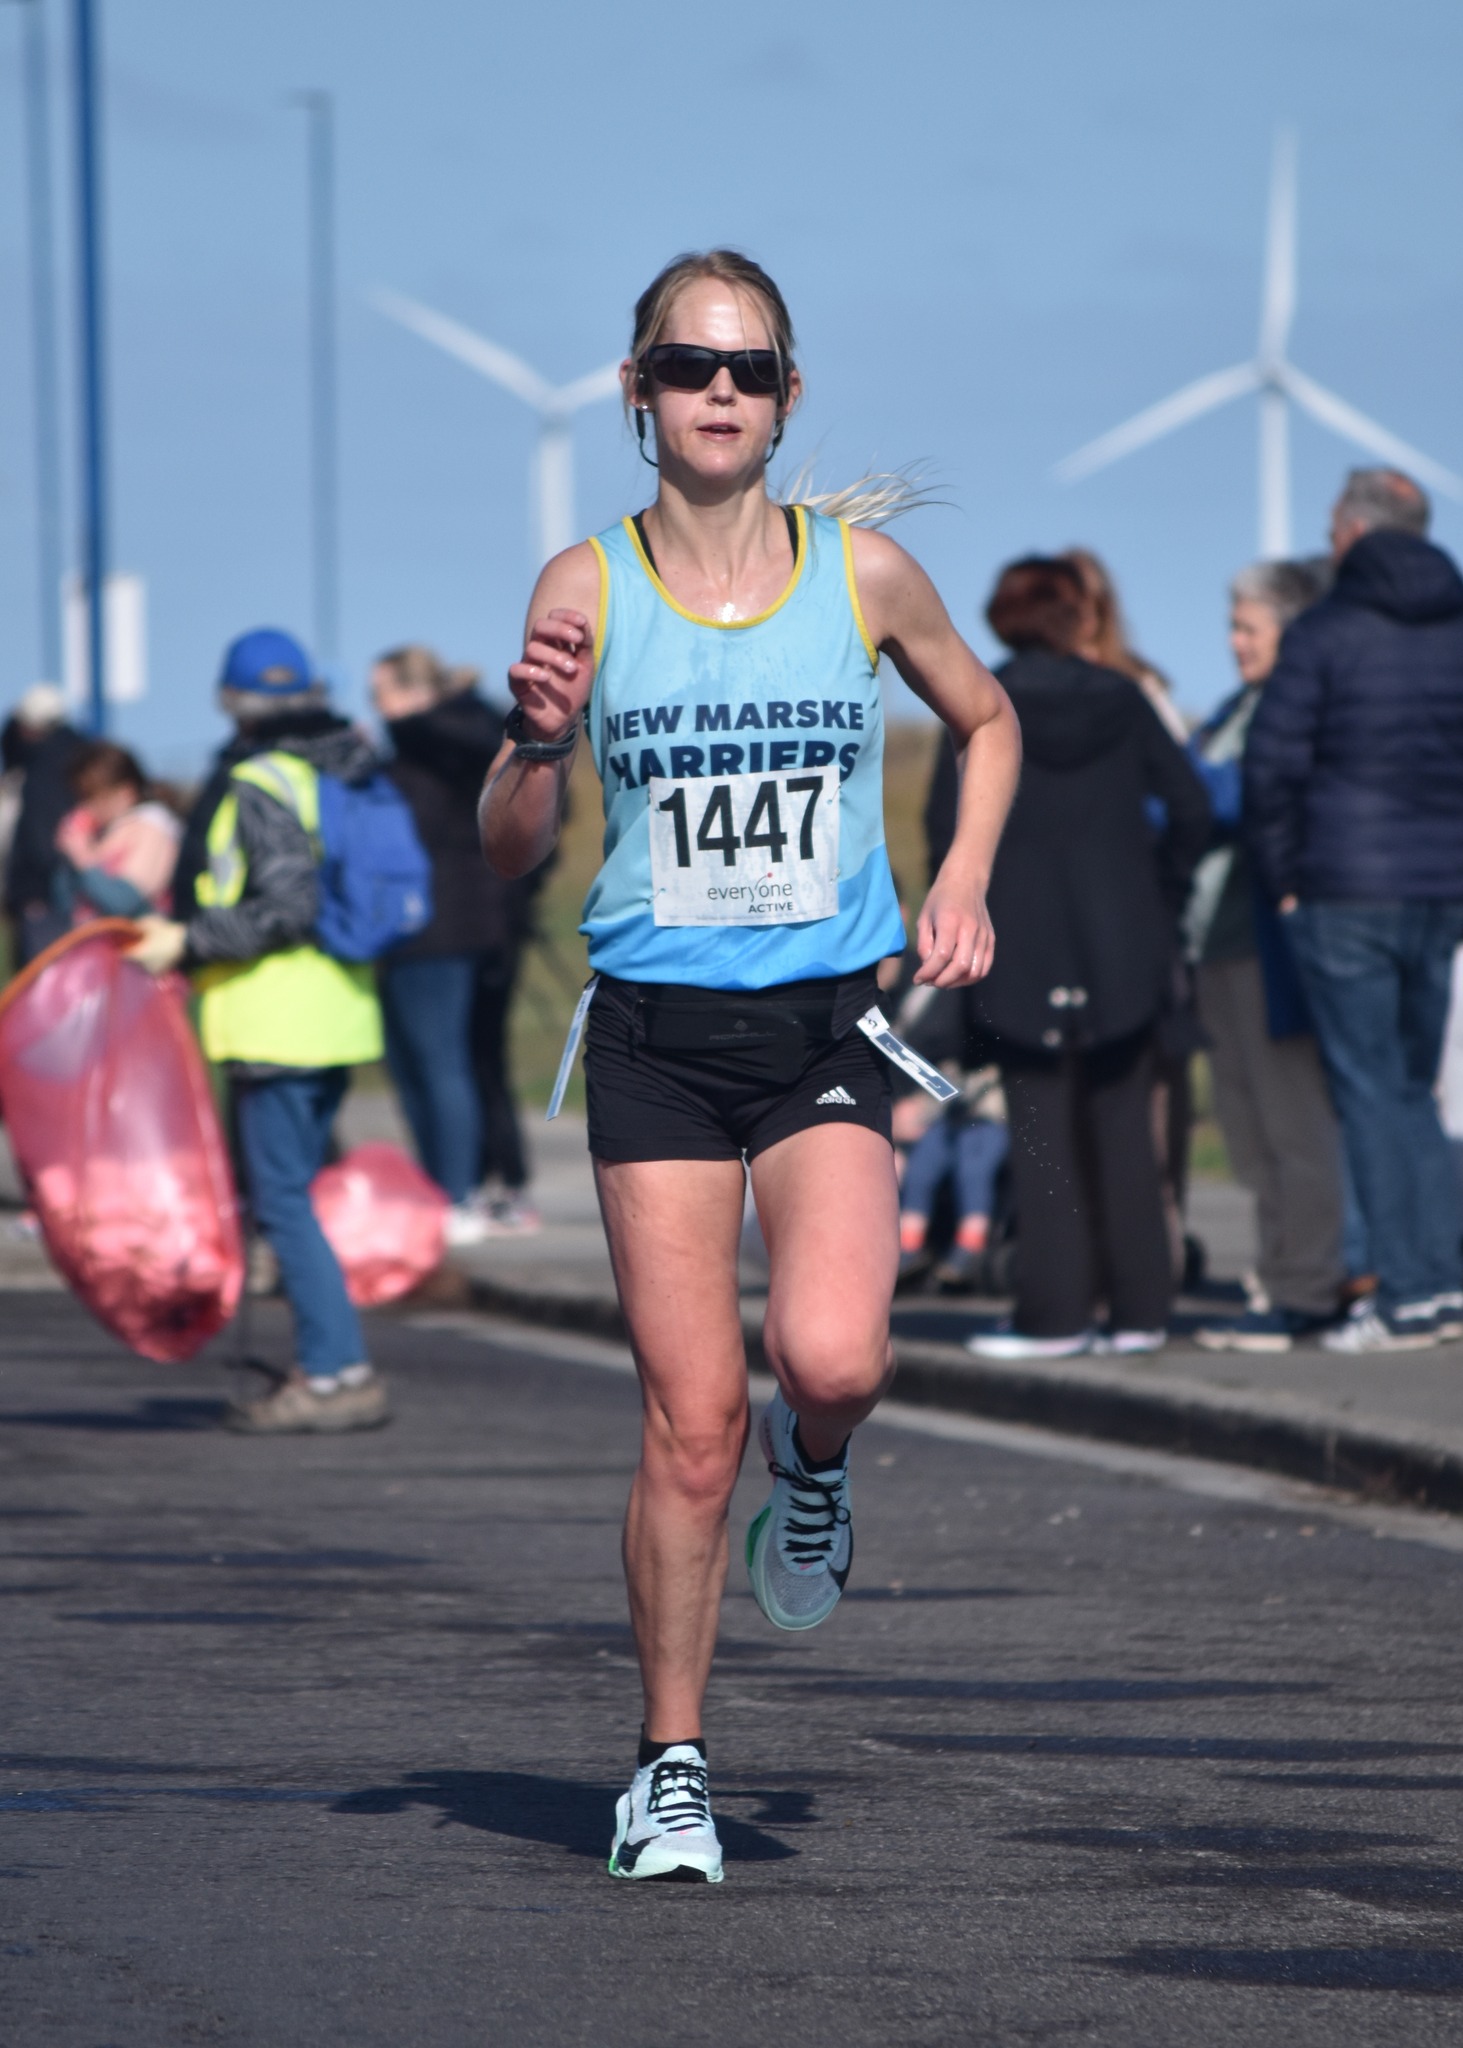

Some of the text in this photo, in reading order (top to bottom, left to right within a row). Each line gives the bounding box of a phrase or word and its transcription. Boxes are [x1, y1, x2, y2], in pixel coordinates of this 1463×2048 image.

[606, 700, 864, 744] NEW MARSKE
[609, 740, 861, 791] HARRIERS
[659, 775, 824, 868] 1447
[707, 874, 793, 903] everyone
[747, 901, 794, 914] ACTIVE
